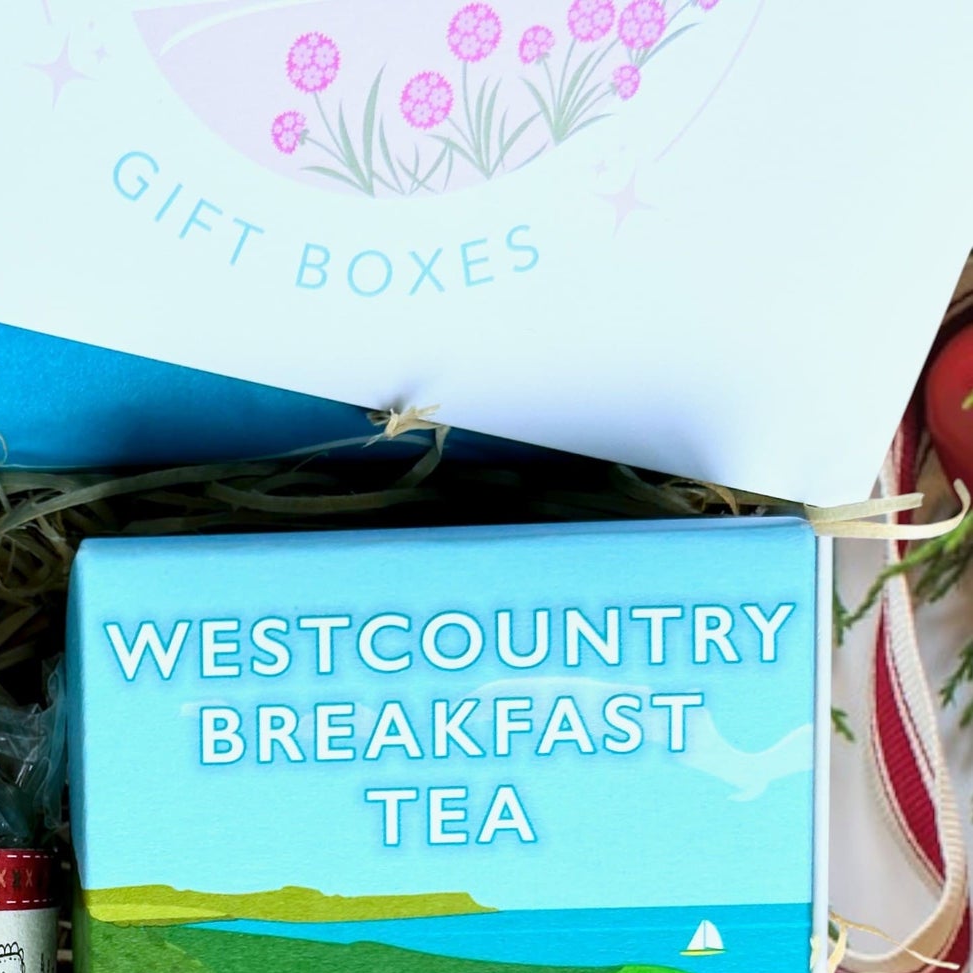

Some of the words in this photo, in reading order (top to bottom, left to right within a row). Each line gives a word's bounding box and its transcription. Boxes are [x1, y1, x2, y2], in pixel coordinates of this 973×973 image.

[112, 151, 265, 266] GIFT
[294, 224, 540, 298] BOXES
[105, 602, 796, 681] WESTCOUNTRY
[199, 692, 705, 765] BREAKFAST
[366, 785, 538, 848] TEA
